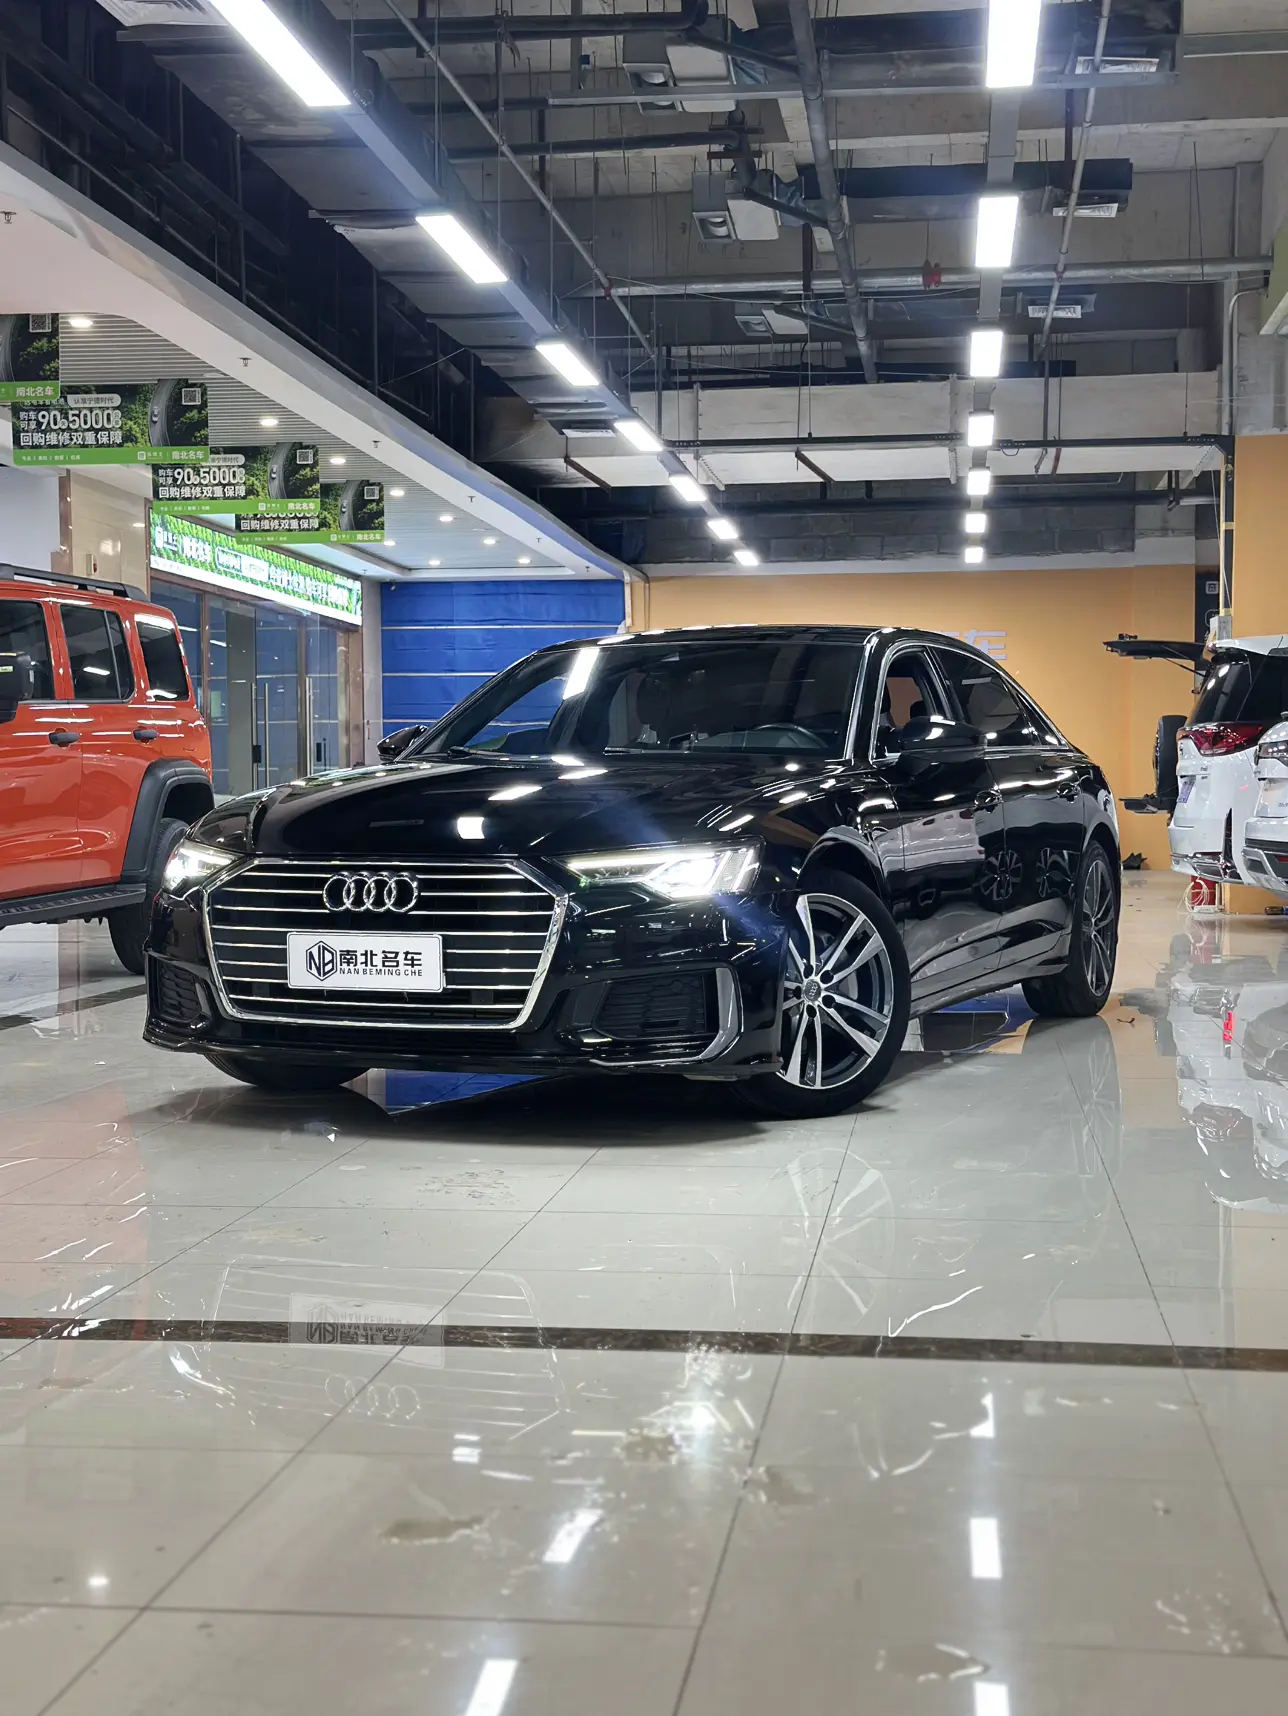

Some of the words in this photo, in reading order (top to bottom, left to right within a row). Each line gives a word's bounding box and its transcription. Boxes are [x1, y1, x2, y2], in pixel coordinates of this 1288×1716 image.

[16, 387, 54, 397] 南北名车
[20, 411, 37, 421] 购车
[20, 431, 122, 446] 回购维修双重保障
[171, 450, 205, 460] 南北名车
[158, 469, 173, 477] 购车
[158, 486, 246, 499] 回购维修双重保障
[240, 518, 319, 530] 回购维修双重保障
[338, 949, 423, 969] 南北名车
[403, 969, 423, 977] CHE
